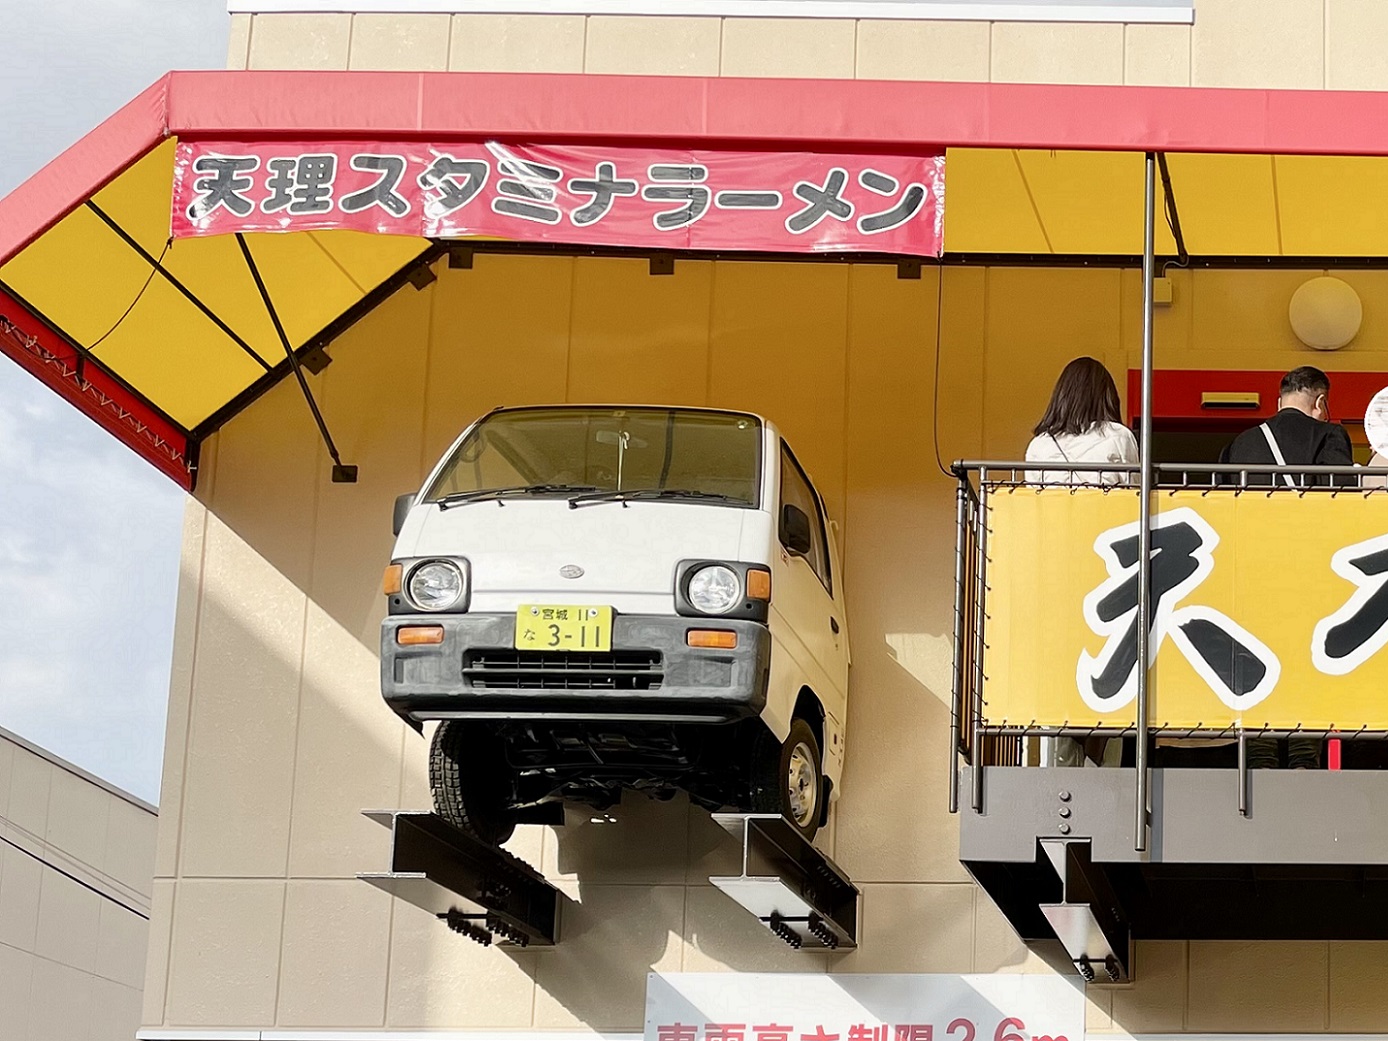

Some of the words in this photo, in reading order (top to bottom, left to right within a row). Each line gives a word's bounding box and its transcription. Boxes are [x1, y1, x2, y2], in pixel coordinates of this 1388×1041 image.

[187, 150, 930, 235] 天理スタミナラーメン
[542, 608, 568, 620] 宮城
[578, 609, 589, 621] 11
[523, 628, 536, 641] な
[547, 623, 600, 647] 3-11
